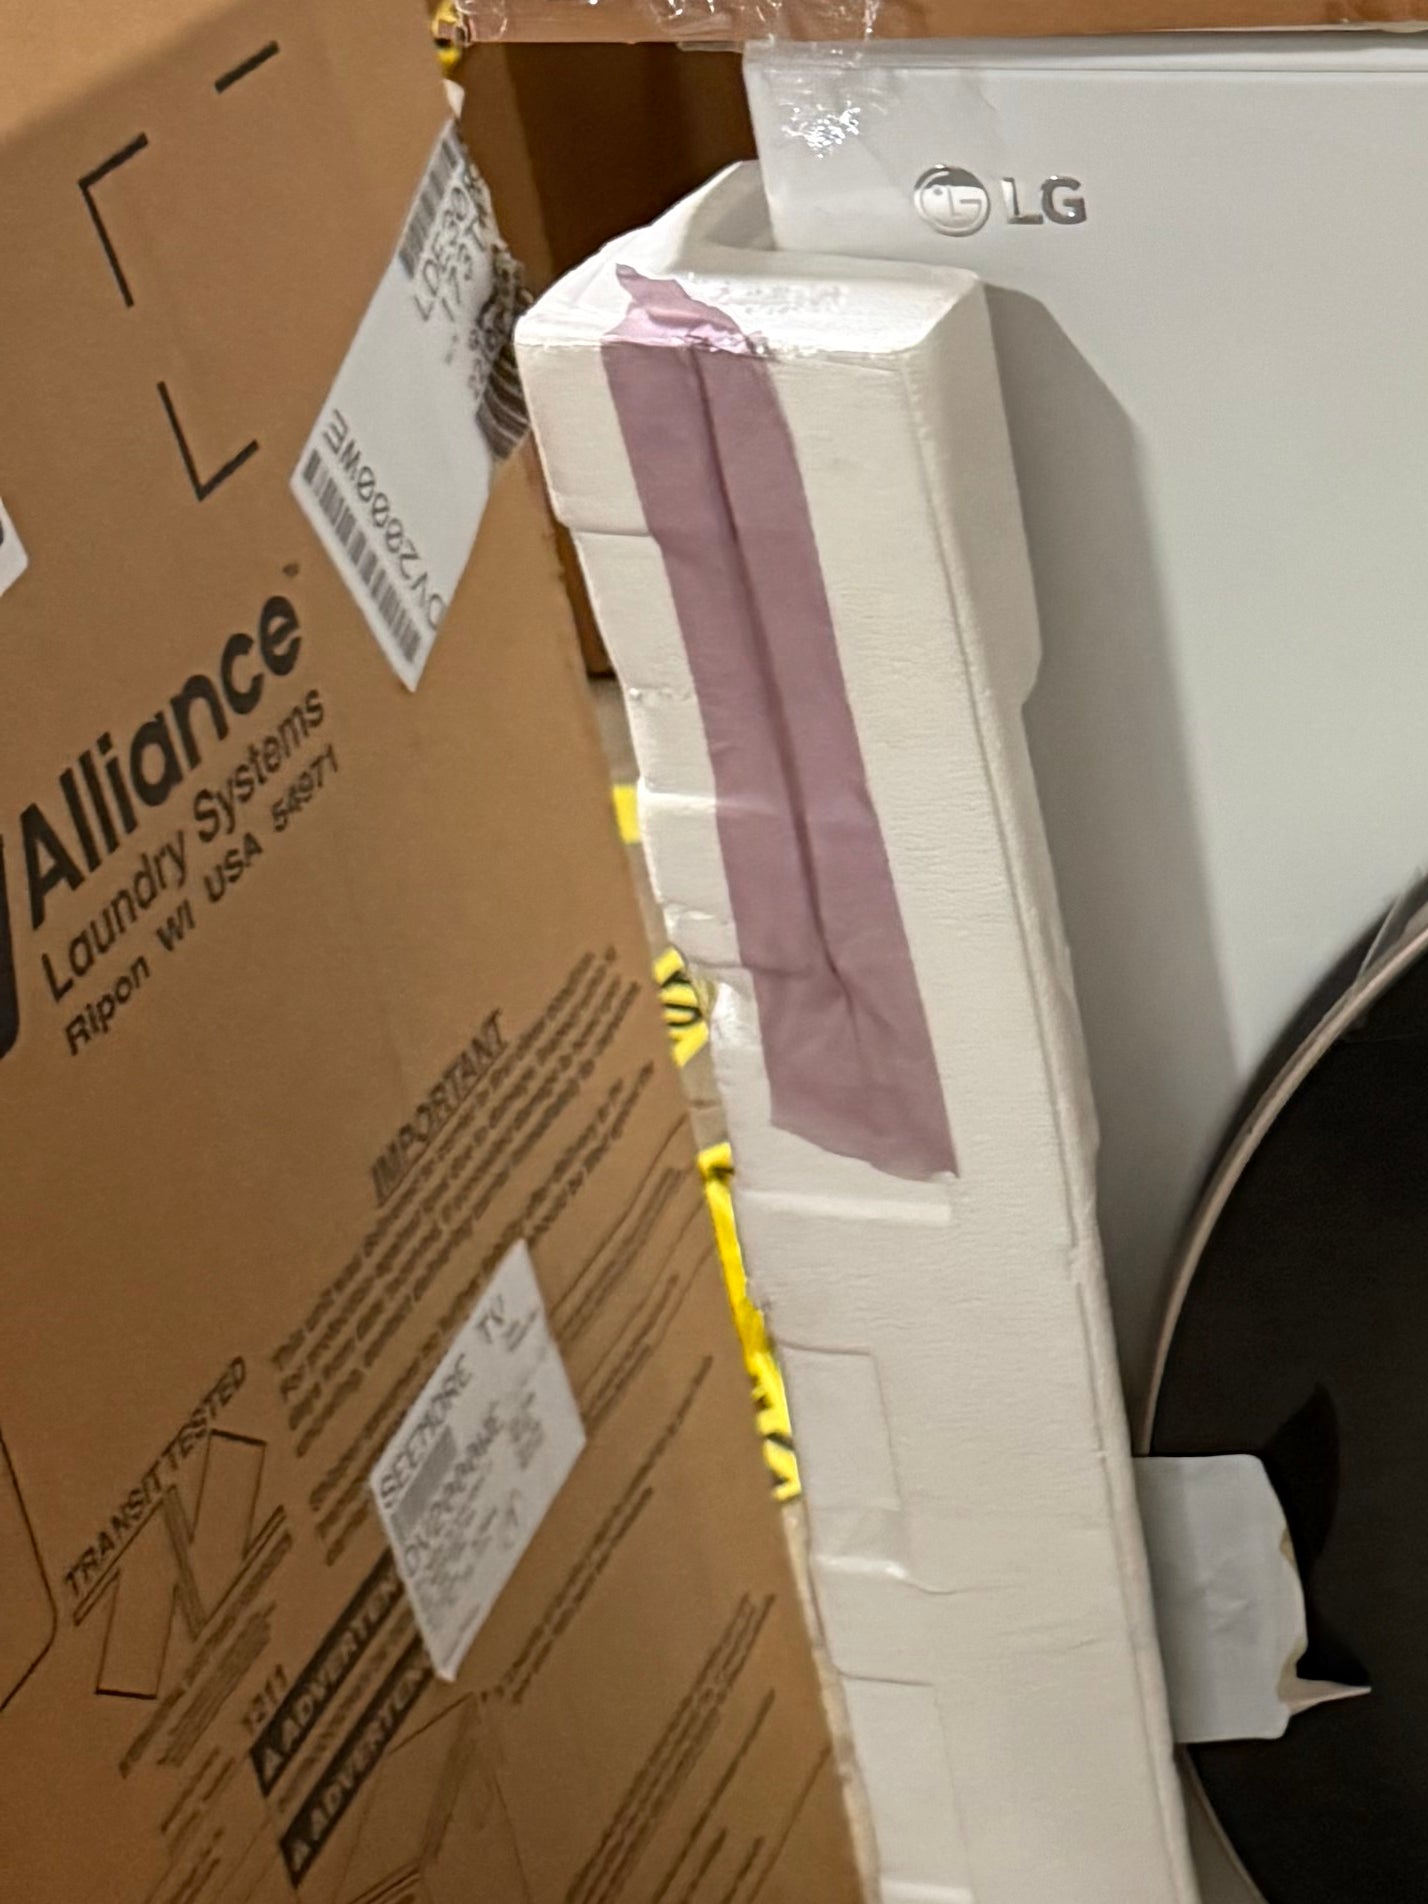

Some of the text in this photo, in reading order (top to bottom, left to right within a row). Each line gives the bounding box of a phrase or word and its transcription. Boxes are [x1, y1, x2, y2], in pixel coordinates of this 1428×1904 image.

[1000, 175, 1087, 225] LG
[19, 594, 302, 931] Alliance
[41, 689, 325, 1003] Laundry Systems
[64, 743, 339, 1056] Ripon WI USA 54971
[372, 1008, 503, 1208] IMPORTANT
[65, 1459, 163, 1597] TRANSIT
[162, 1355, 247, 1471] TESTED
